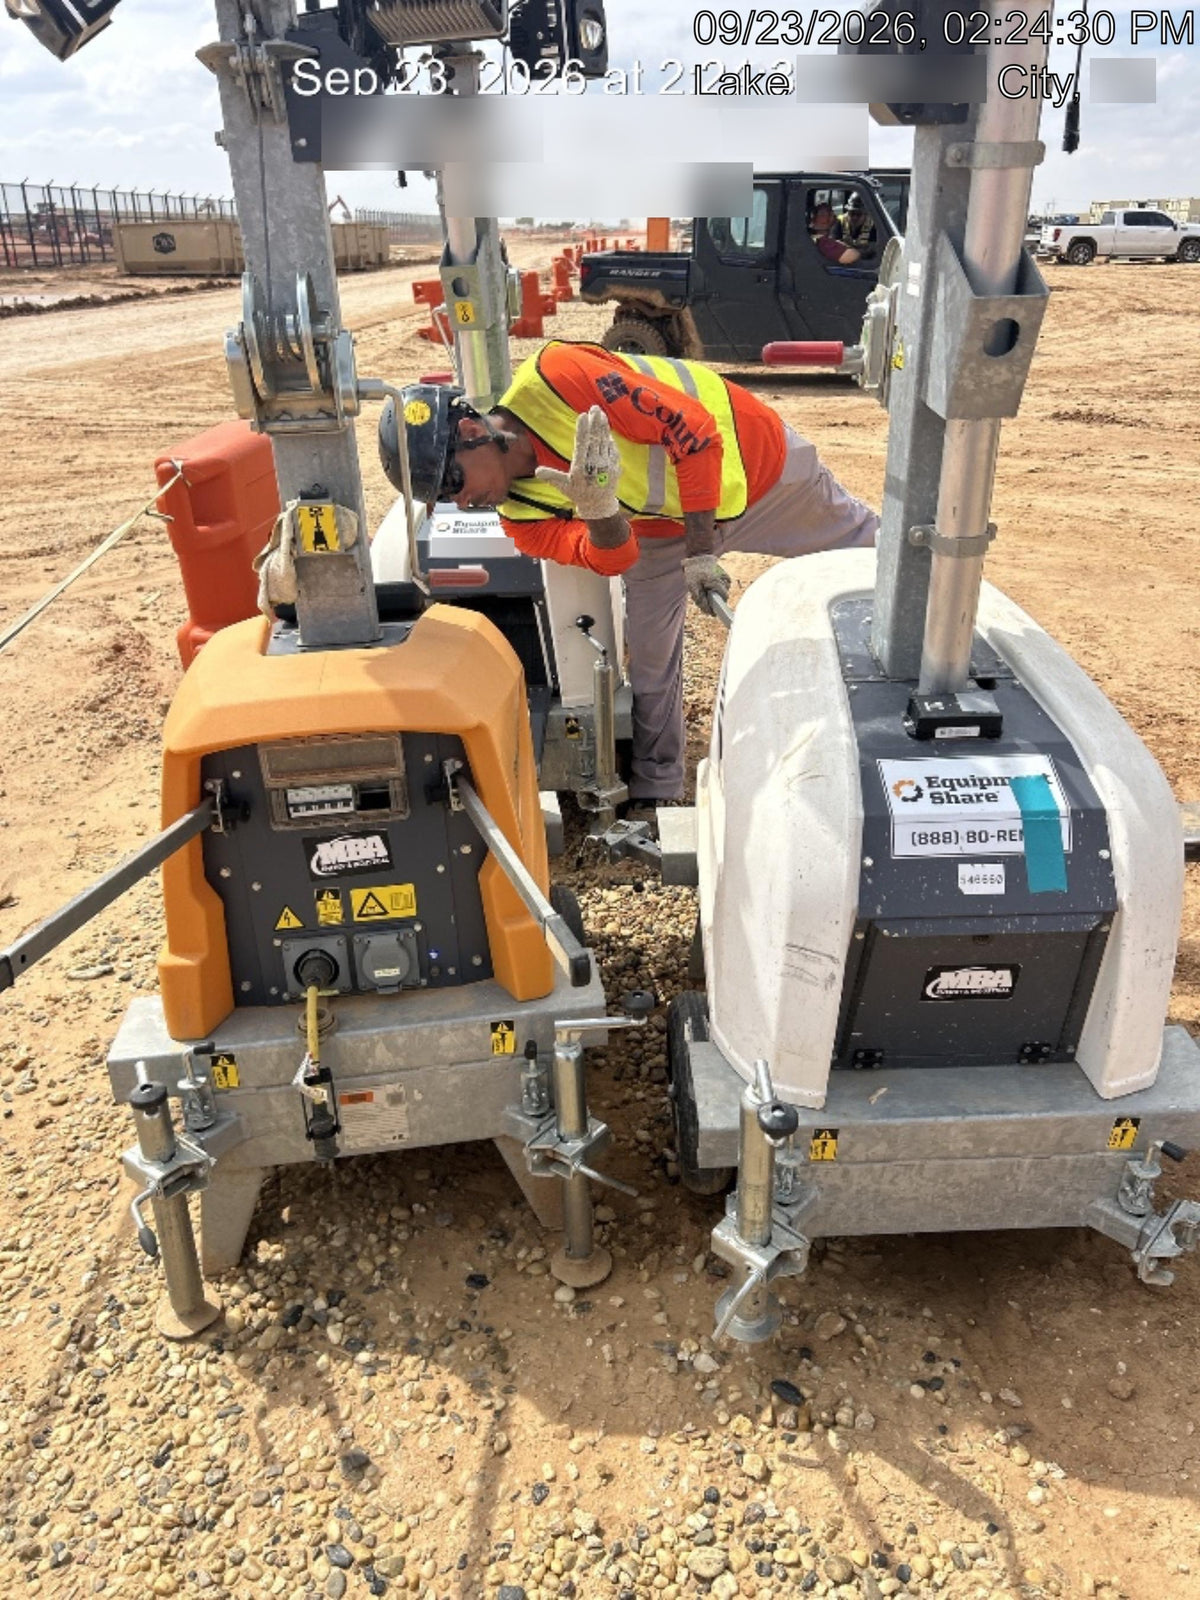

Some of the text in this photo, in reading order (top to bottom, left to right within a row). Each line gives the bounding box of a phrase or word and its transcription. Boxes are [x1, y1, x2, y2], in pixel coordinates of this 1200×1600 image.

[924, 772, 1053, 791] Equipmt
[929, 790, 1000, 805] Share
[911, 830, 960, 847] (888)
